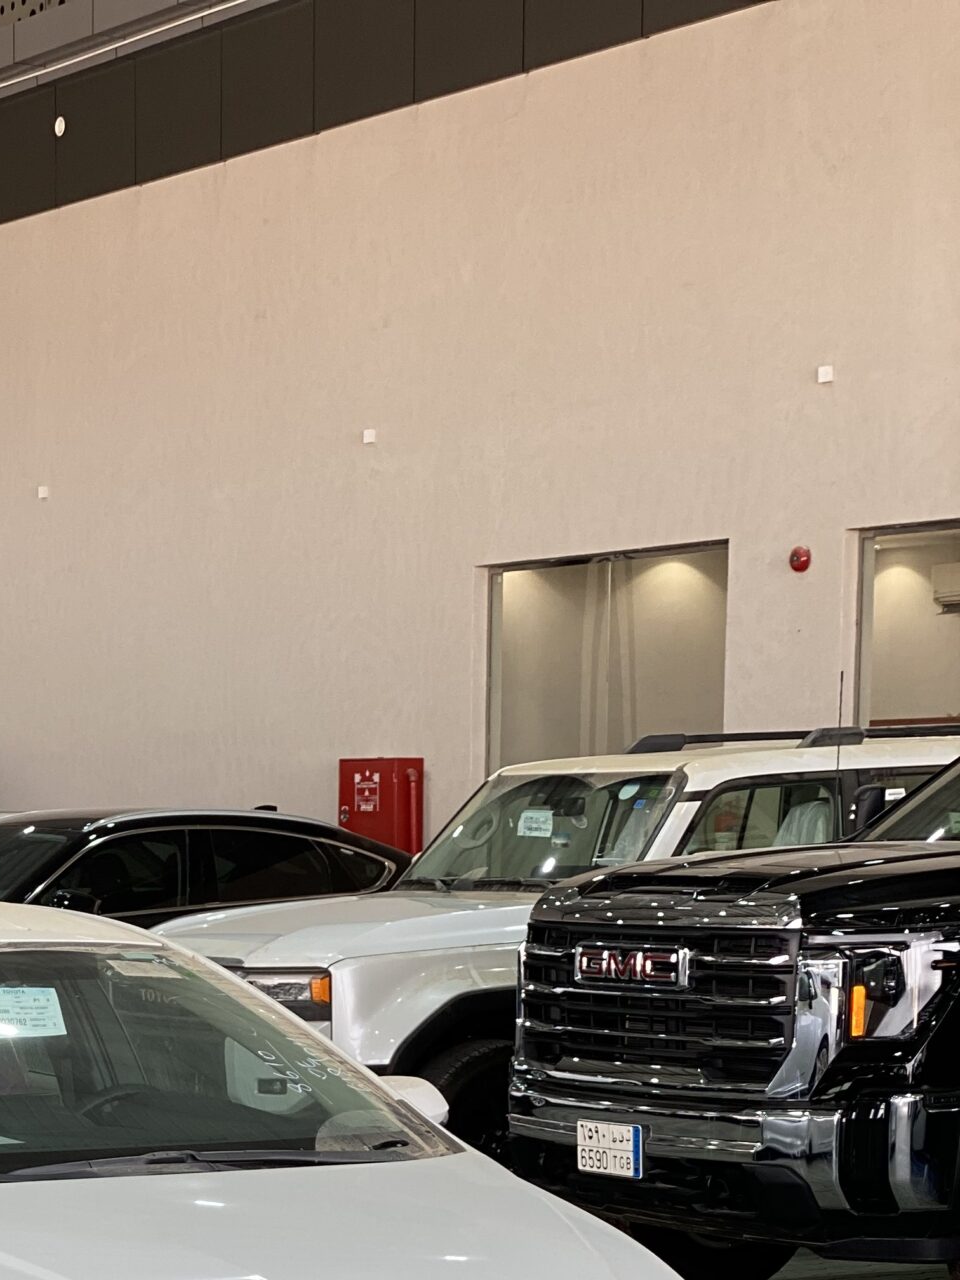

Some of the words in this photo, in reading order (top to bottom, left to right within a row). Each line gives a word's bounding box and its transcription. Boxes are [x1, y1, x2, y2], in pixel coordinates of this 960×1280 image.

[579, 949, 678, 982] GMC
[580, 1148, 609, 1170] 6590
[612, 1154, 632, 1171] TGB
